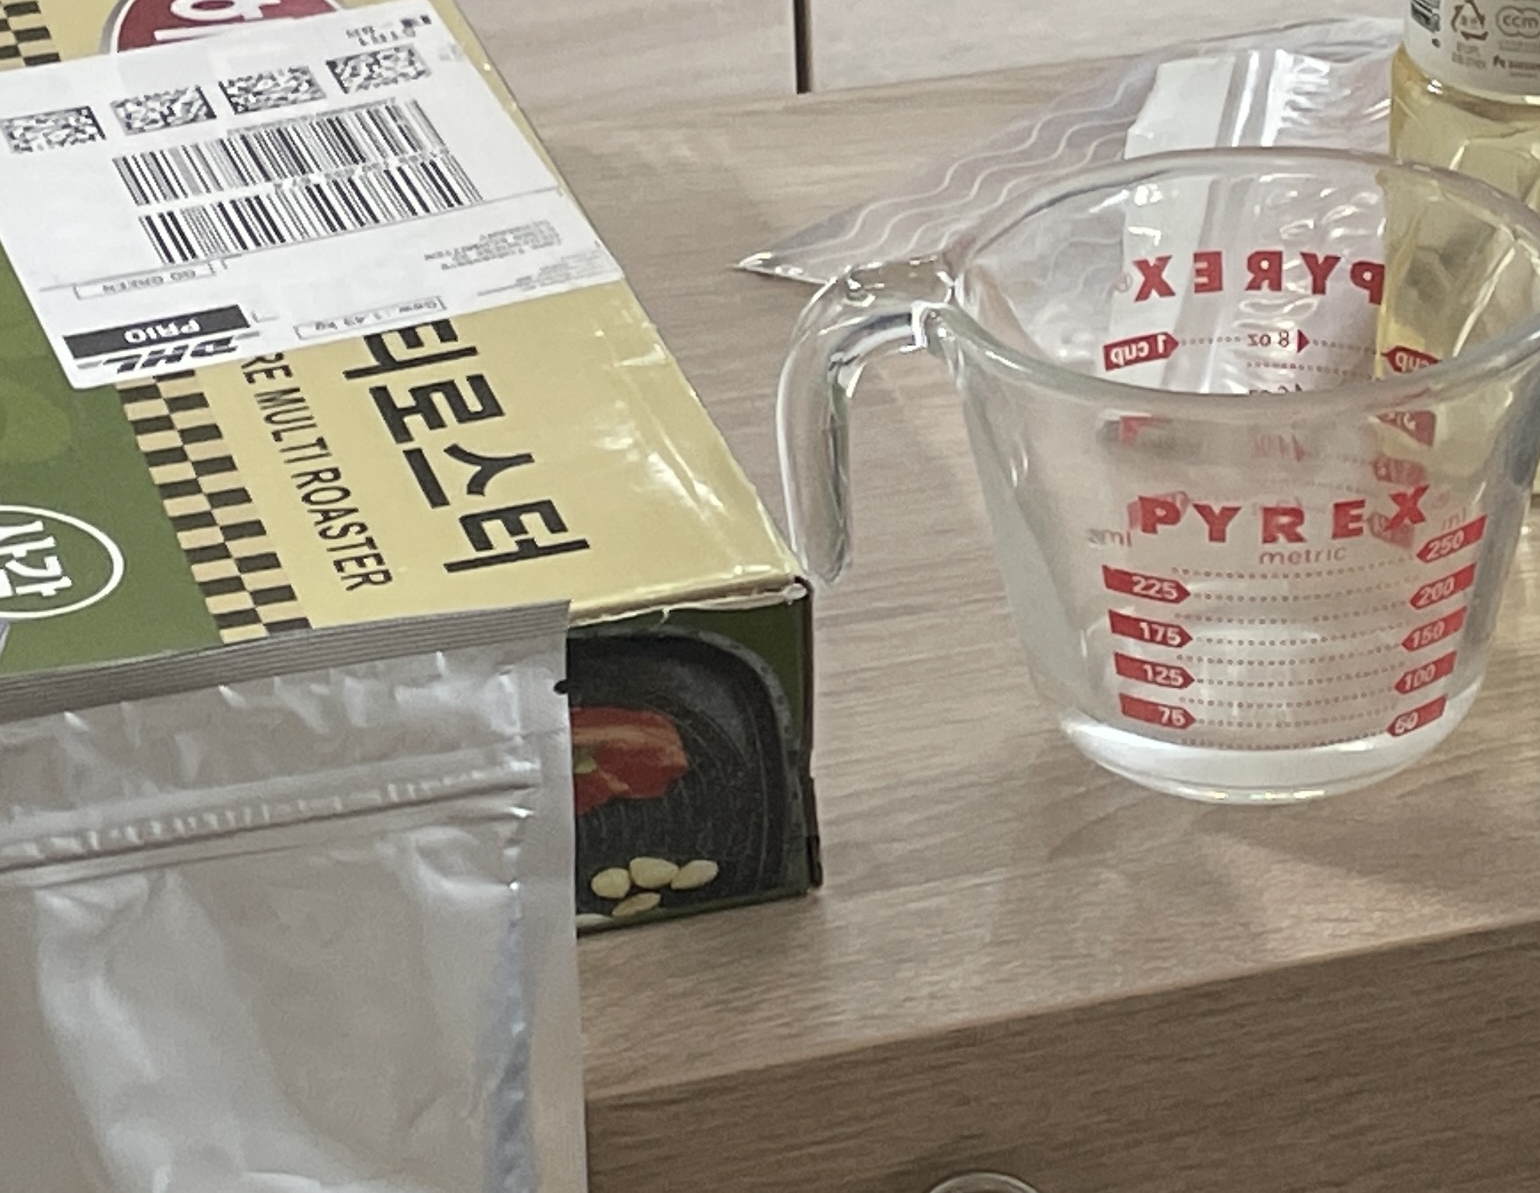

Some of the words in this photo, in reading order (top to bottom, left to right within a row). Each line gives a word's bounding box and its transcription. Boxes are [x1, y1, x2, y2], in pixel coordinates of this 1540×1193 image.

[1502, 14, 1540, 28] ccm
[124, 317, 201, 345] PRIO
[103, 335, 238, 374] DHL
[255, 386, 334, 466] MULTI
[343, 319, 590, 574] 티로스터
[1138, 485, 1430, 544] PYREX
[291, 466, 393, 592] ROASTER
[1259, 547, 1347, 565] metric
[1428, 527, 1465, 561] 250
[1131, 576, 1178, 600] 225
[1419, 577, 1456, 607] 200
[1139, 621, 1182, 645] 175
[1410, 621, 1446, 649] 150
[1143, 663, 1184, 687] 125
[1403, 663, 1436, 691] 100
[1158, 706, 1185, 727] 75
